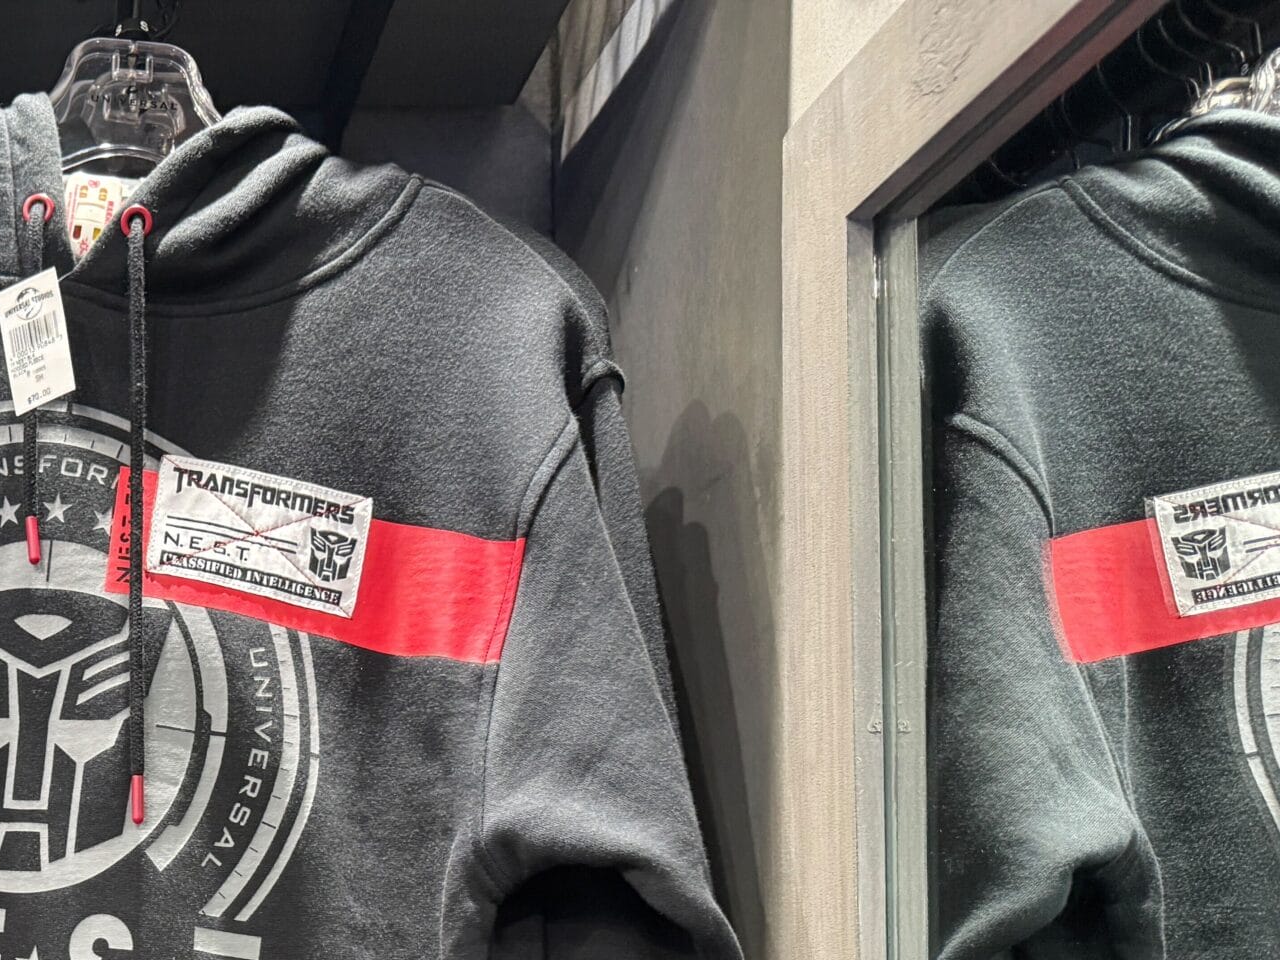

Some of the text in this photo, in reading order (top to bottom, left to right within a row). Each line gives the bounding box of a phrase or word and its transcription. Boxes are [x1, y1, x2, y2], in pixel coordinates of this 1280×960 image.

[91, 94, 178, 111] UNIVERSAL
[27, 387, 51, 404] $70.00
[173, 466, 355, 525] TRANSFORMERS
[161, 551, 340, 604] CLASSIFIED INTELLIGENCE
[201, 646, 273, 868] UNIVERSAL
